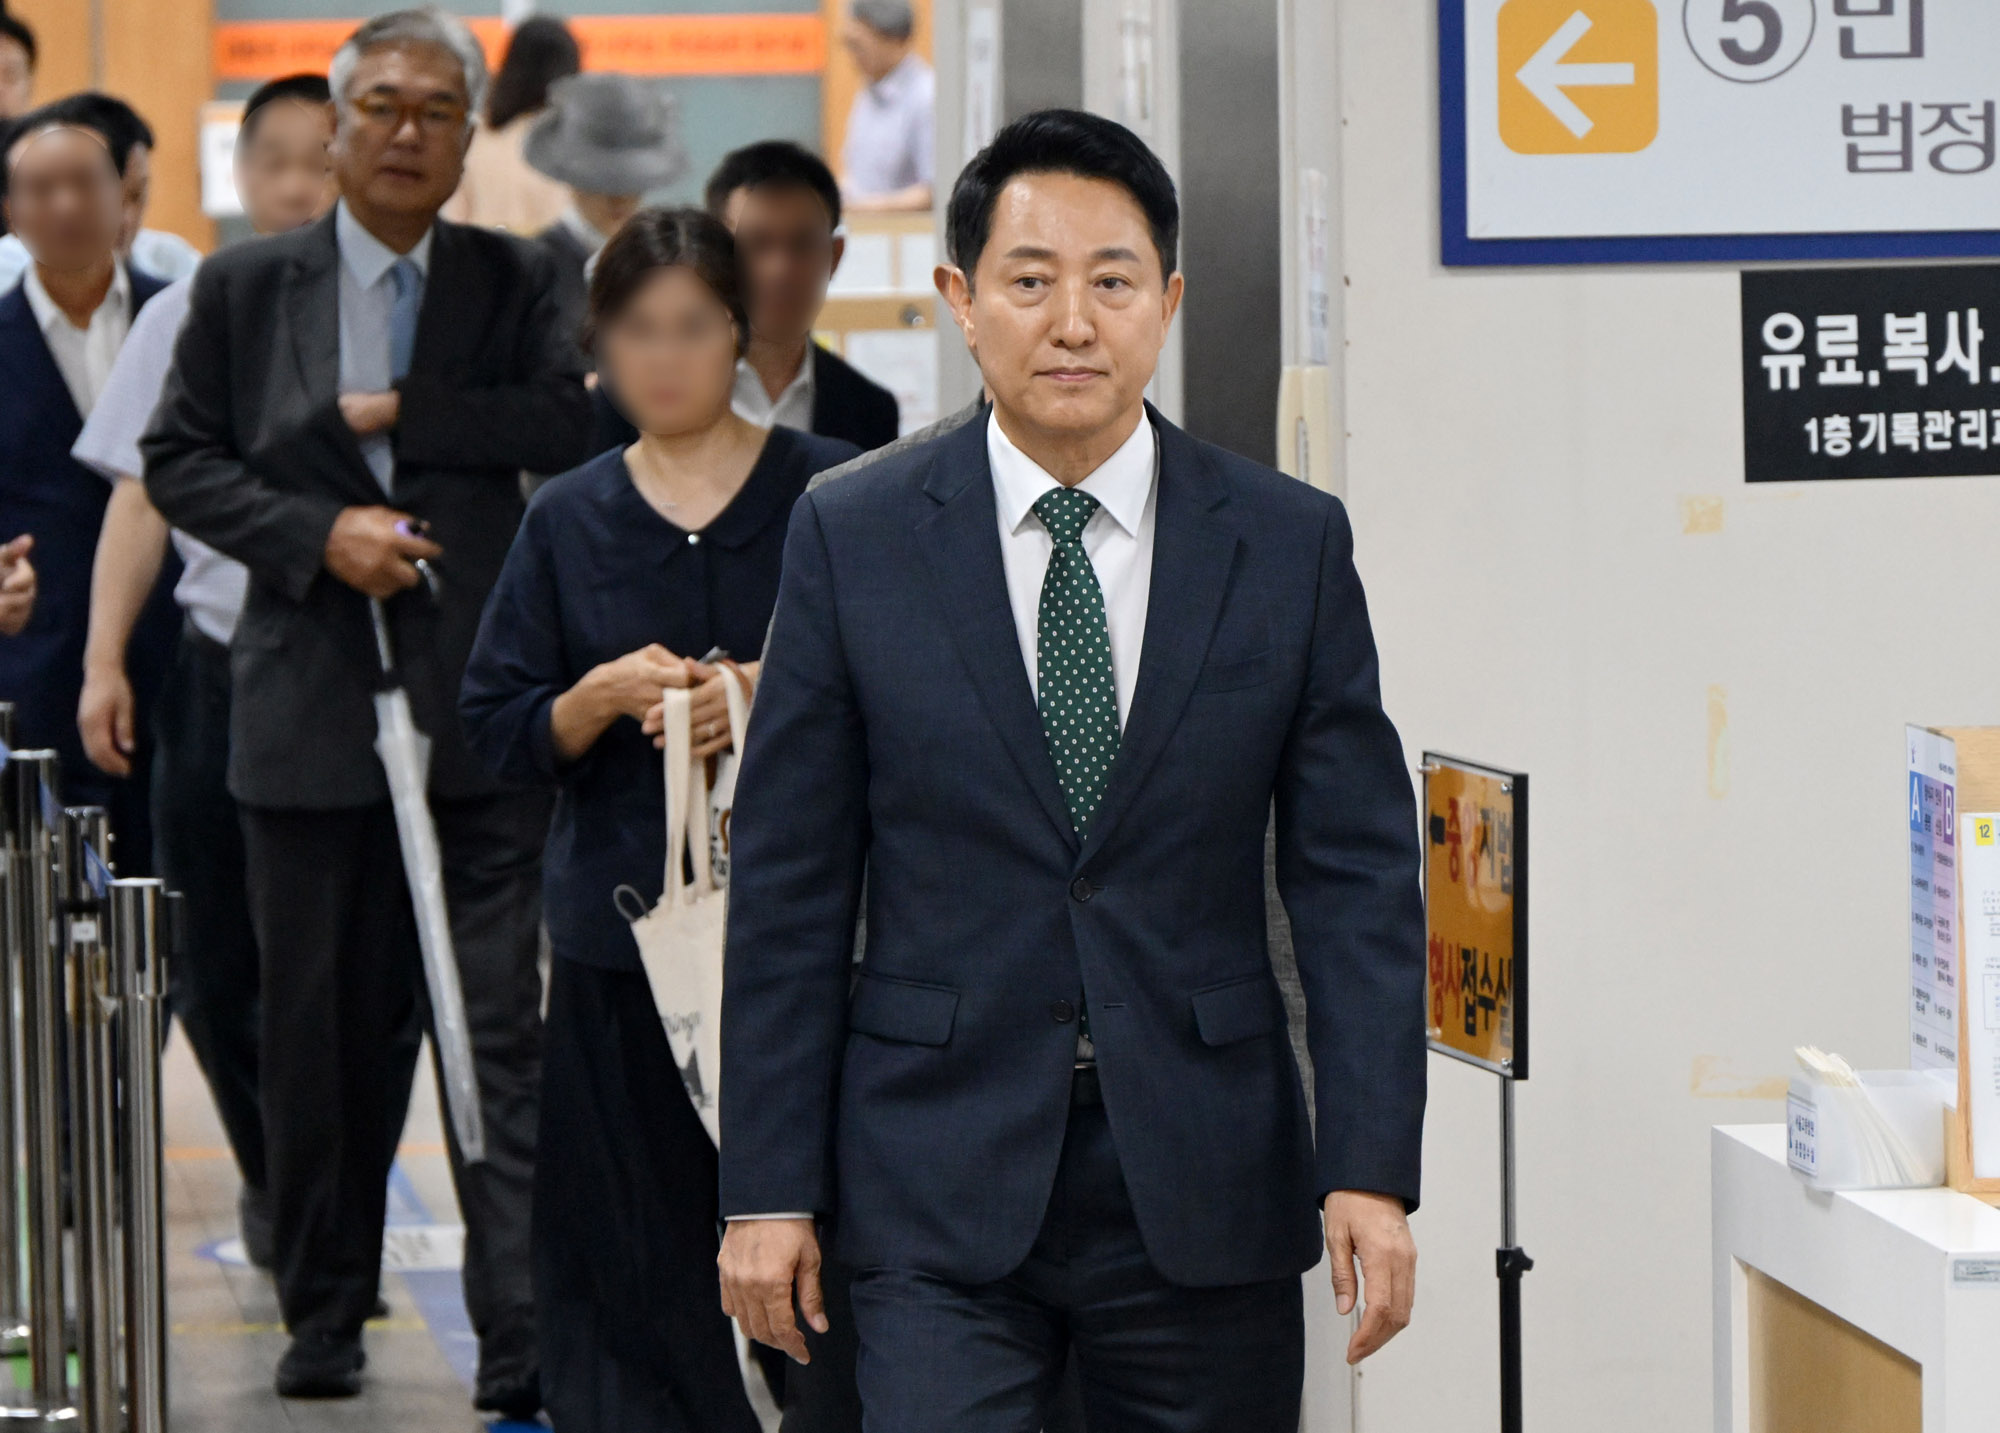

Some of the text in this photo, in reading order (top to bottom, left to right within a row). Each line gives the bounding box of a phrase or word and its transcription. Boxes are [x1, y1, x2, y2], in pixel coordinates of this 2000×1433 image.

[1719, 0, 1783, 66] 5
[1840, 99, 1998, 175] 법정
[1911, 776, 1921, 823] A
[1945, 789, 1953, 835] B
[1979, 824, 1990, 838] 12
